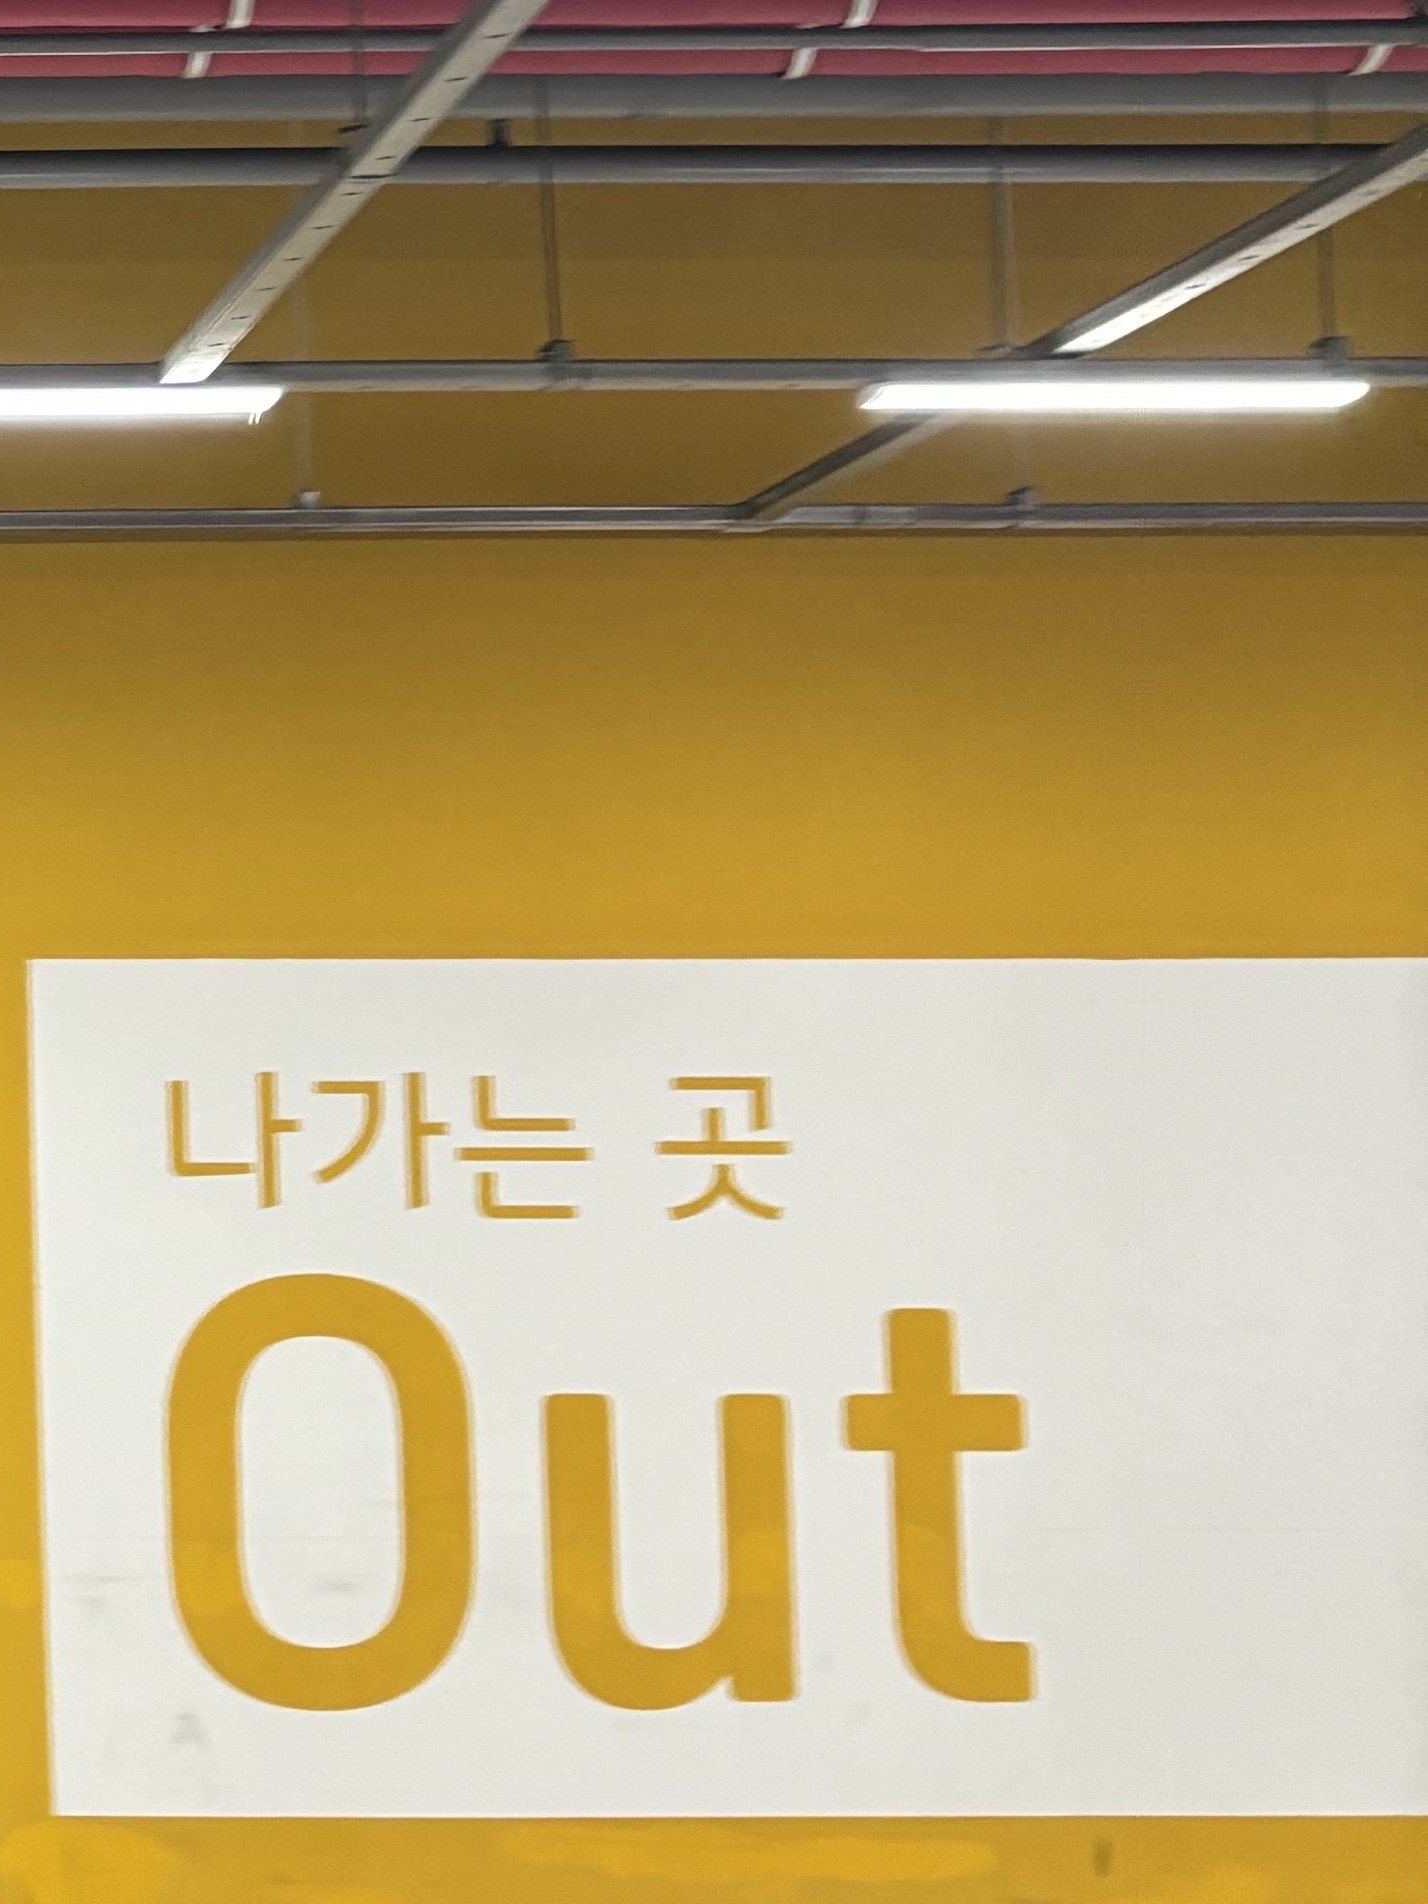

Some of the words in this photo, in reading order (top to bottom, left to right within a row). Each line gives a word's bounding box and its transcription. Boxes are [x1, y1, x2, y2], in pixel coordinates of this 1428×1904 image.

[164, 1070, 596, 1221] 나가는
[653, 1074, 793, 1221] 곳
[165, 1272, 1037, 1712] Out
